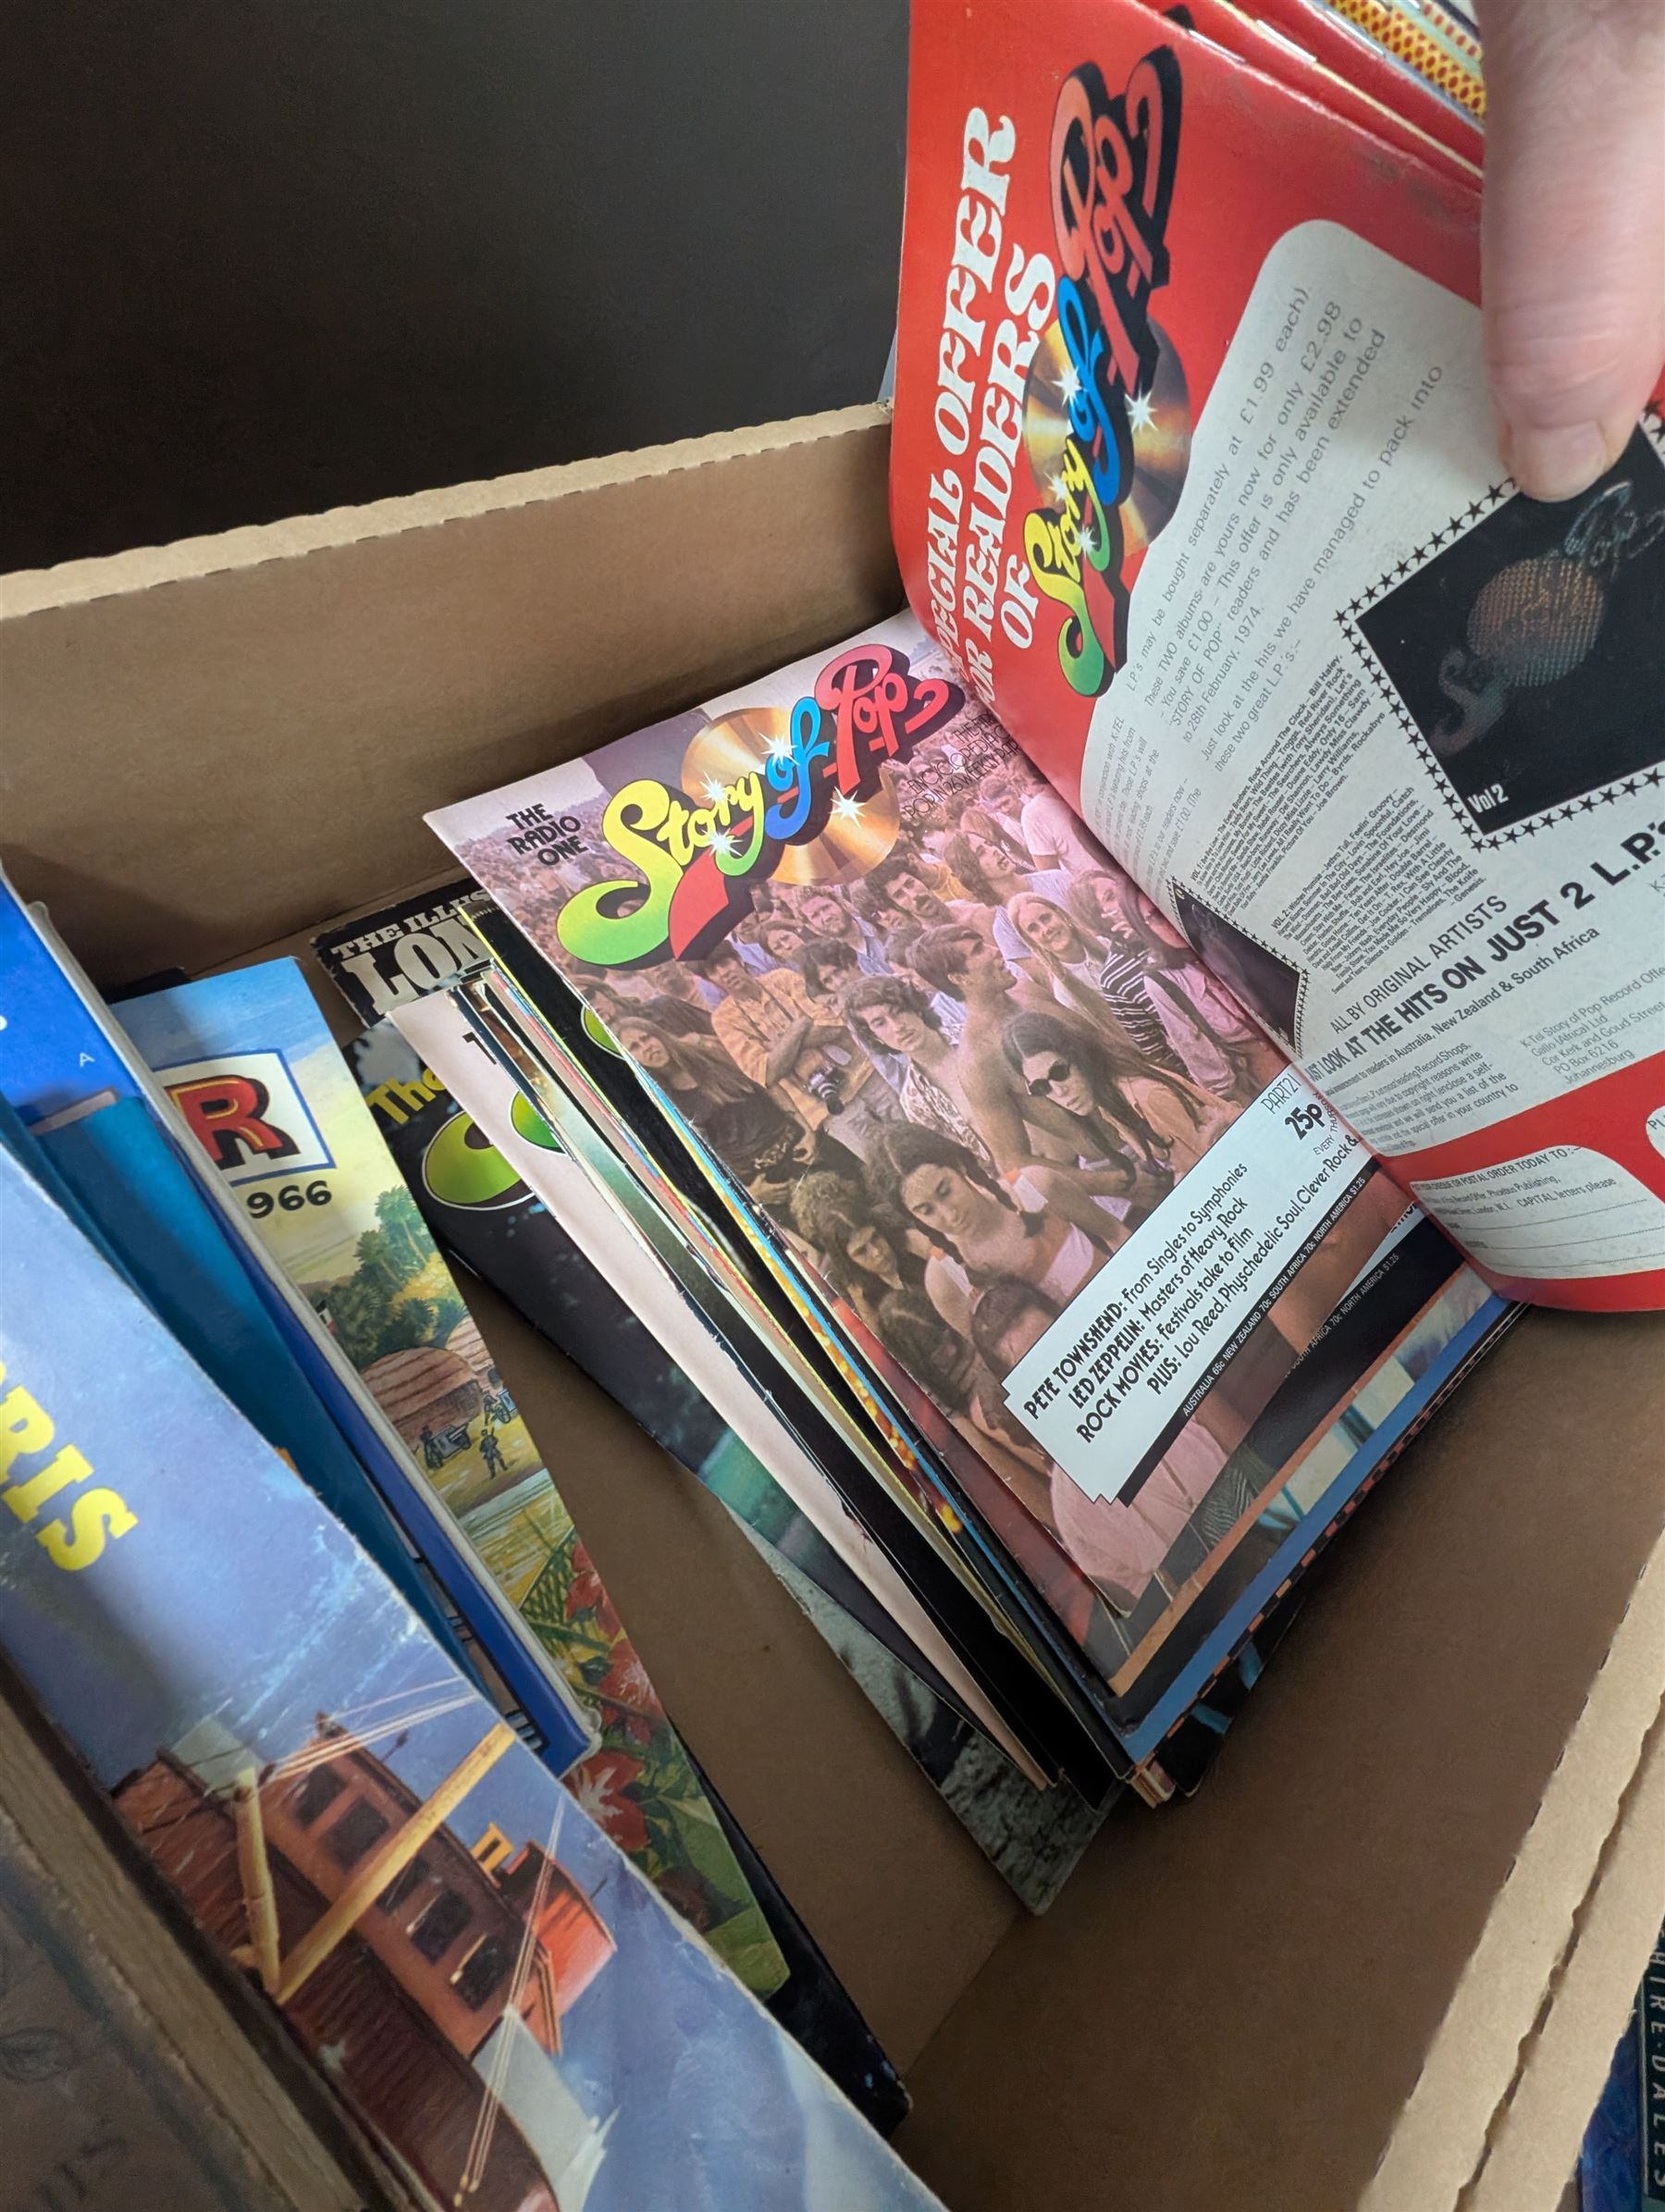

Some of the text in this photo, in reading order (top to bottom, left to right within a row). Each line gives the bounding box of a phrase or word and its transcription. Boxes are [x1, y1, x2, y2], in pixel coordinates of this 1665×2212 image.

[934, 107, 1016, 455] OFFER
[964, 242, 1055, 641] READERS
[1141, 631, 1156, 658] may
[1152, 609, 1165, 626] be
[1162, 553, 1190, 602] bought
[1189, 463, 1230, 546] separately
[1229, 437, 1242, 455] at
[1240, 362, 1274, 424] £1.99
[1144, 677, 1163, 706] These
[1158, 642, 1177, 671] TWO
[1202, 562, 1215, 586] are
[1215, 513, 1240, 557] yours
[1239, 466, 1260, 506] now
[1258, 434, 1276, 459] for
[1278, 382, 1304, 425] only
[1301, 301, 1344, 372] £2.98
[1162, 318, 1362, 706] You save £1.00 This offer is only available to
[1192, 663, 1204, 684] OF
[1203, 623, 1222, 661] POP"
[1227, 567, 1260, 620] readers
[1260, 527, 1280, 561] and
[1276, 491, 1300, 523] has
[1296, 437, 1330, 483] been
[1328, 328, 1385, 428] extended
[1001, 555, 1038, 649] OF
[1024, 439, 1111, 697] Story
[1202, 366, 1443, 761] Just look at the hits we have managed to pack into
[952, 720, 975, 747] THE
[1183, 732, 1192, 742] to
[1188, 705, 1206, 732] 28th
[1202, 651, 1240, 703] February,
[1215, 688, 1272, 772] these two great
[506, 804, 553, 831] THE
[557, 643, 949, 966] Story of Pop
[902, 791, 938, 822] POP
[945, 775, 966, 797] 26
[962, 754, 1001, 788] WEEKLY
[1376, 800, 1418, 840] Foundations,
[1400, 809, 1434, 843] Desmond
[1401, 809, 1420, 827] Love
[1468, 784, 1508, 812] Vol 2
[506, 816, 581, 855] RADIO
[536, 835, 588, 869] ONE
[331, 924, 407, 958] THE
[1317, 1047, 1350, 1074] LOOK
[1345, 1036, 1367, 1058] AT
[1361, 1014, 1403, 1044] THE
[1394, 983, 1448, 1023] HITS
[1442, 956, 1486, 989] ON
[1486, 899, 1560, 961] JUST
[1560, 883, 1595, 909] 2
[1330, 896, 1507, 1034] ALL BY ORIGINAL ARTISTS
[1365, 929, 1599, 1075] readers Australia, New Zealand & South Africa
[79, 1051, 95, 1069] A
[1285, 1104, 1333, 1140] 25p
[1314, 1134, 1334, 1155] EVERY
[1515, 1154, 1549, 1170] TODAY
[1517, 1191, 1558, 1206] CAPITAL
[1024, 1164, 1247, 1419] PETE TOWNSHEND: From Singles to Symphonies
[1068, 1198, 1248, 1409] LED ZEPPELIN: Masters of Heavy Rock
[1147, 1135, 1361, 1395] PLUS: Lou Reed, Physchedelic Soul, Clever Rock &
[1179, 1177, 1365, 1416] AUSTRALIA 65c NEW ZEALAND 70c SOUTH AFRICA 70c NORTH AMERICA $1.25
[1340, 1269, 1384, 1314] NORTH AMERICA
[1077, 1229, 1253, 1443] ROCK MOVIES: Festivals take to Film
[0, 1354, 139, 1572] RIS
